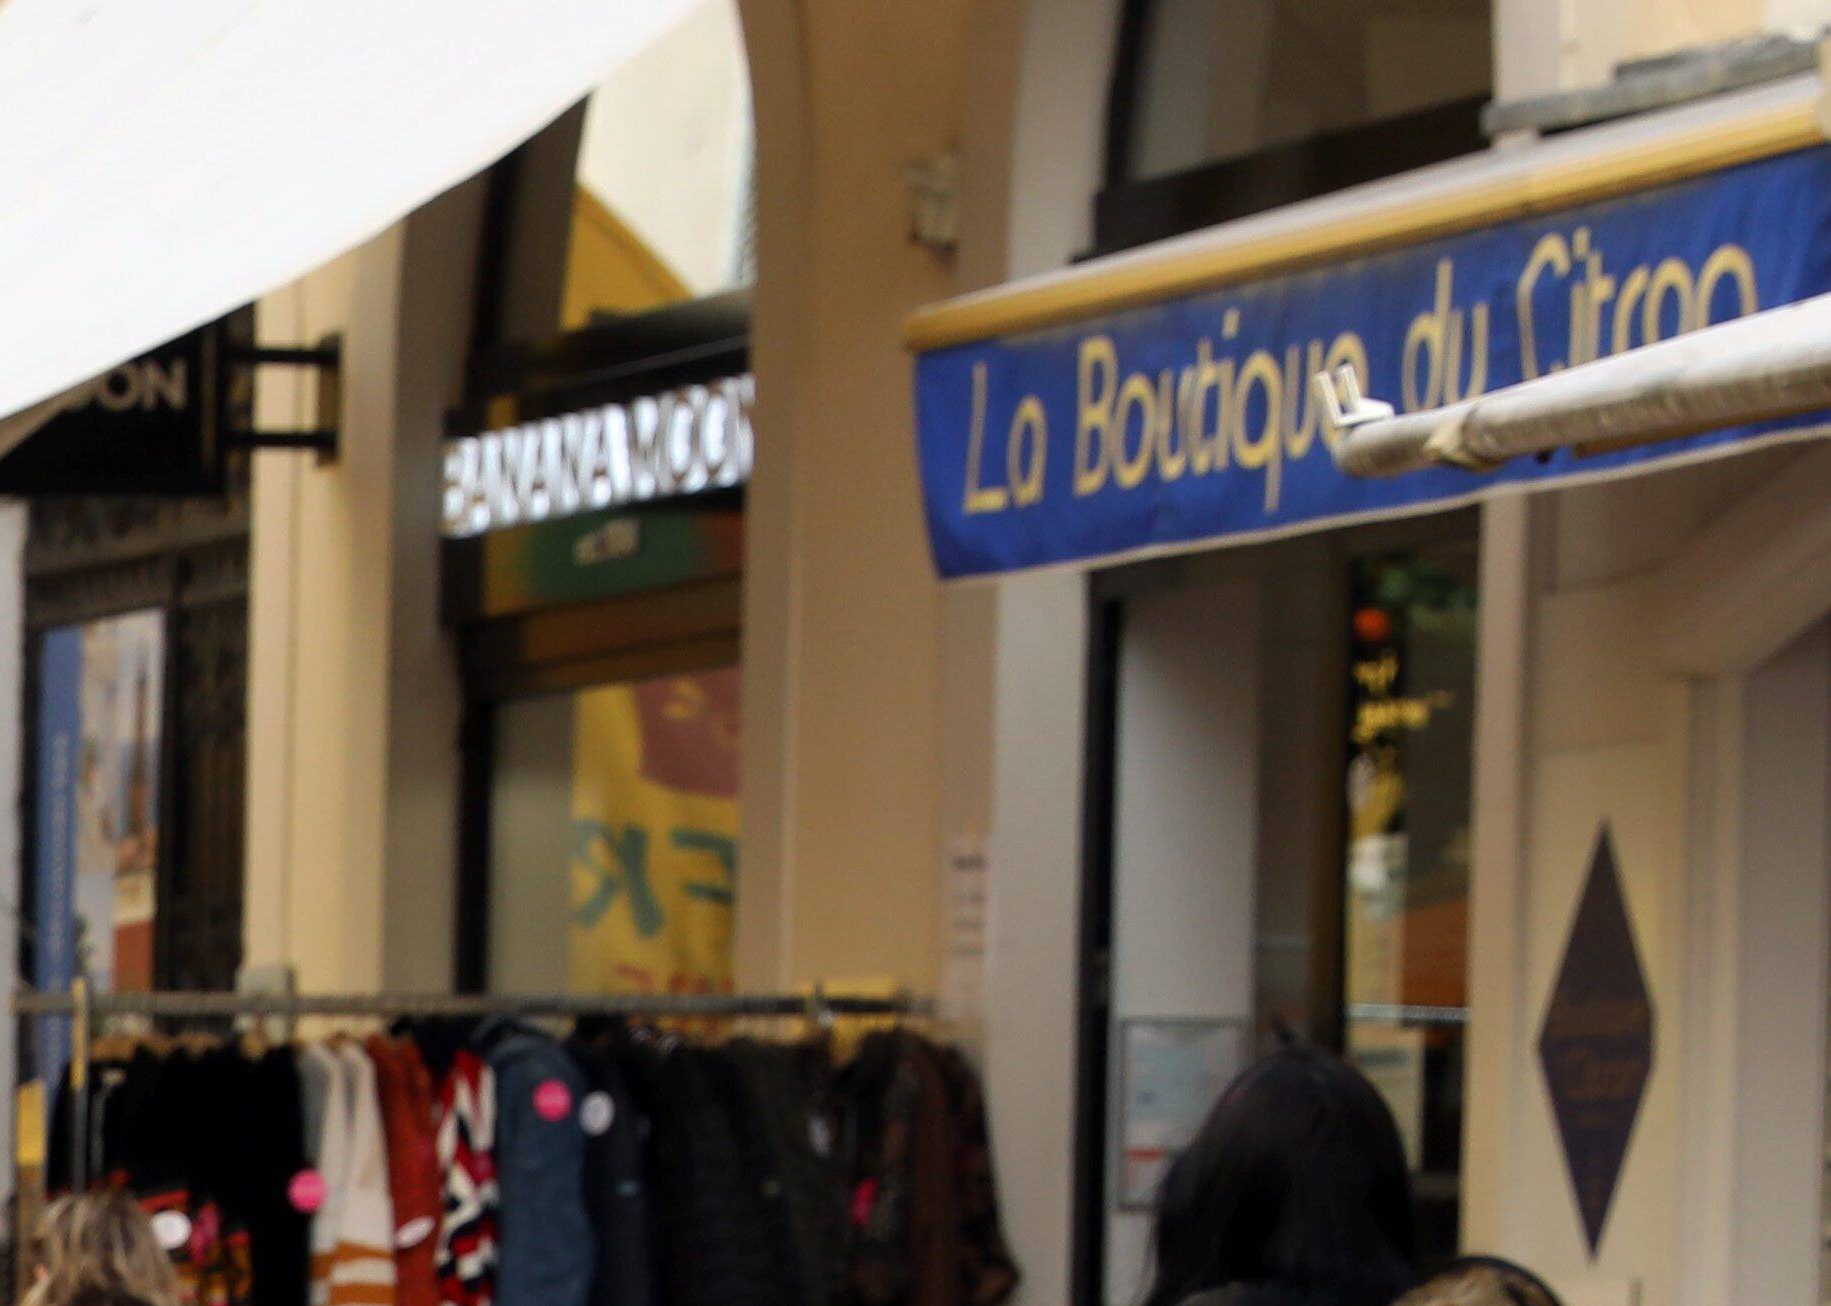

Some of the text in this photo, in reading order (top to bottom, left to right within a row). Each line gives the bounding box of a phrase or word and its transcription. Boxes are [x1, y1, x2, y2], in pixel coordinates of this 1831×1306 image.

[962, 225, 1760, 516] La Boutique du Citron
